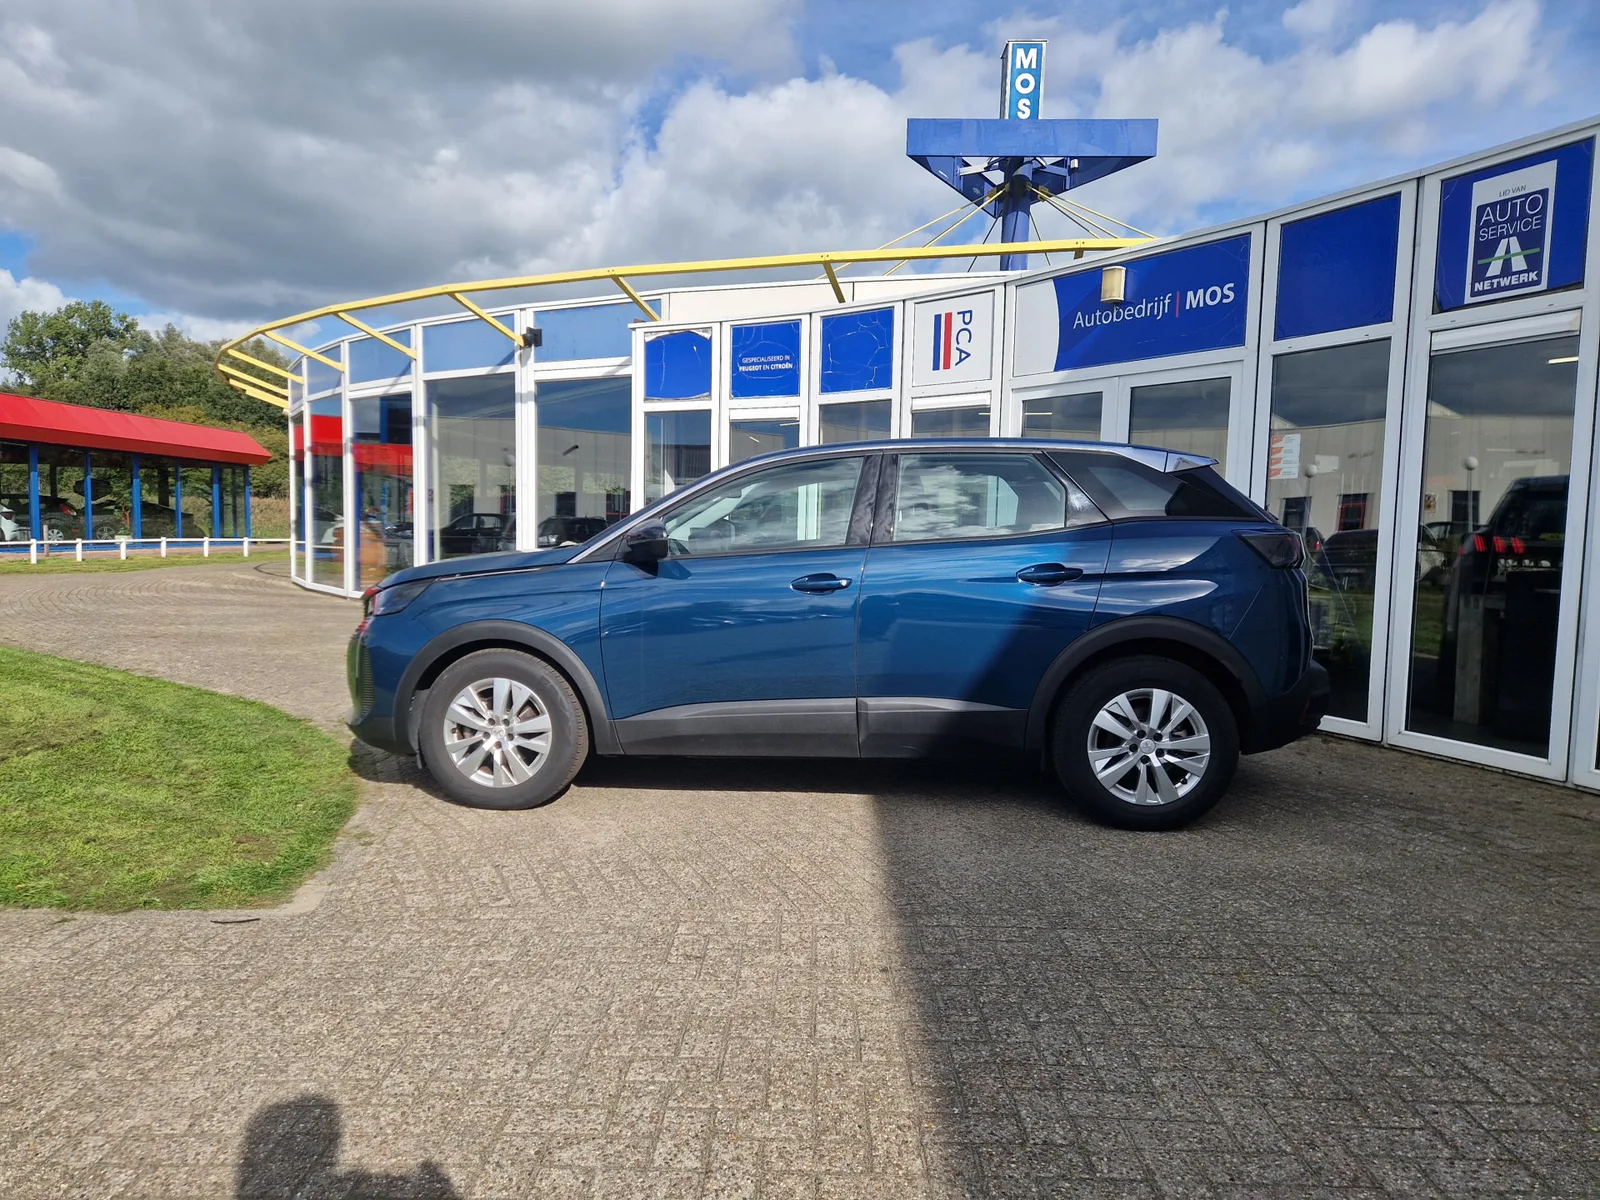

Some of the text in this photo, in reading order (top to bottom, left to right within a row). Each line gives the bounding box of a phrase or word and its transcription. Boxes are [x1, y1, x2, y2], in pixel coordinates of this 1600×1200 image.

[1015, 48, 1038, 119] MOS
[1499, 185, 1527, 198] LID VAN
[1480, 193, 1543, 226] AUTO
[1479, 215, 1542, 242] SERVICE
[1474, 271, 1538, 292] NETWERK
[1073, 282, 1235, 330] Autobedrijf MOS
[955, 309, 973, 367] PCA
[742, 355, 784, 363] GESPECIALISEERD
[770, 362, 793, 370] CITROËN
